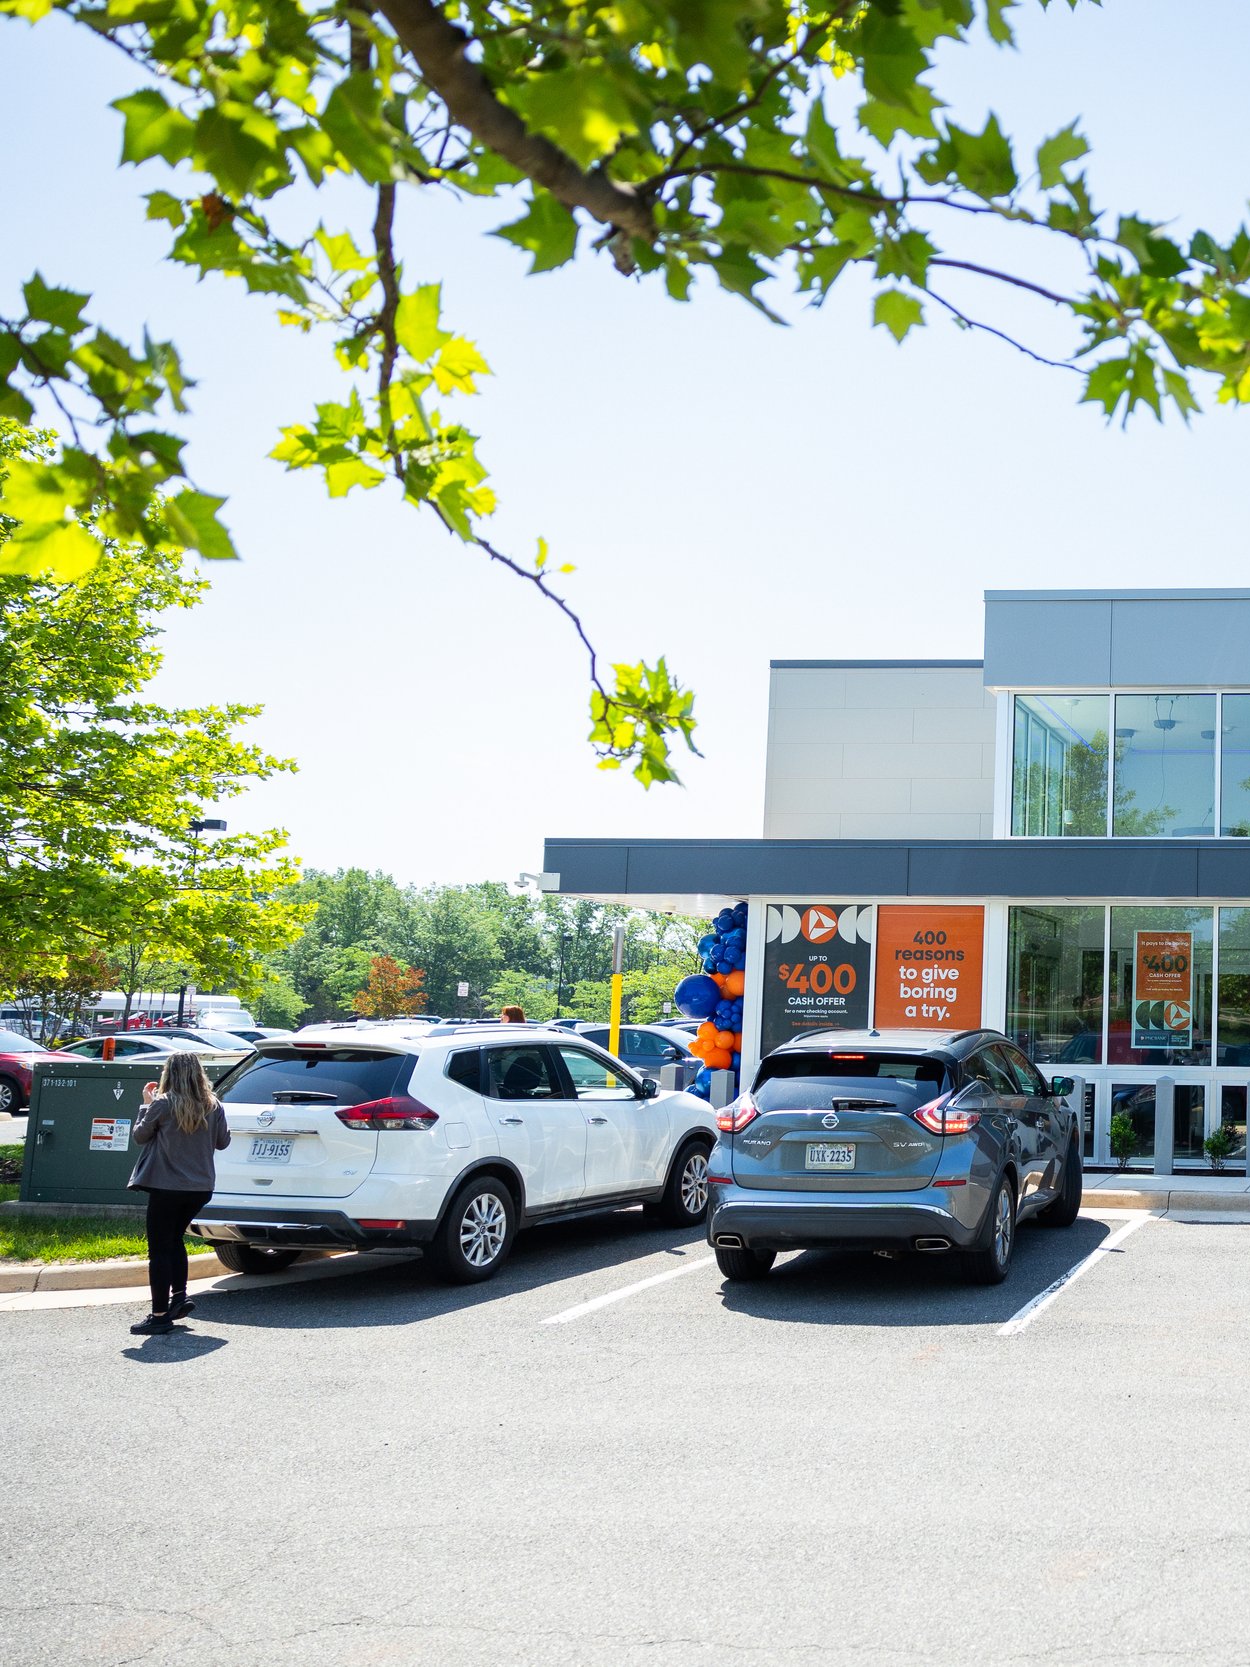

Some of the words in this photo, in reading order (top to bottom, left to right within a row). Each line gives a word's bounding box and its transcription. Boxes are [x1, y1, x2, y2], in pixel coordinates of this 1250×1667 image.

[913, 930, 947, 945] 400
[895, 949, 965, 961] reasons
[1142, 955, 1188, 973] $400
[778, 963, 857, 995] $400
[899, 965, 918, 980] to
[921, 963, 960, 984] give
[788, 997, 814, 1005] CASH
[816, 997, 846, 1006] OFFER
[900, 982, 957, 1003] boring
[905, 1005, 917, 1017] a
[921, 1003, 951, 1021] try.
[809, 1150, 852, 1163] UXK-2235
